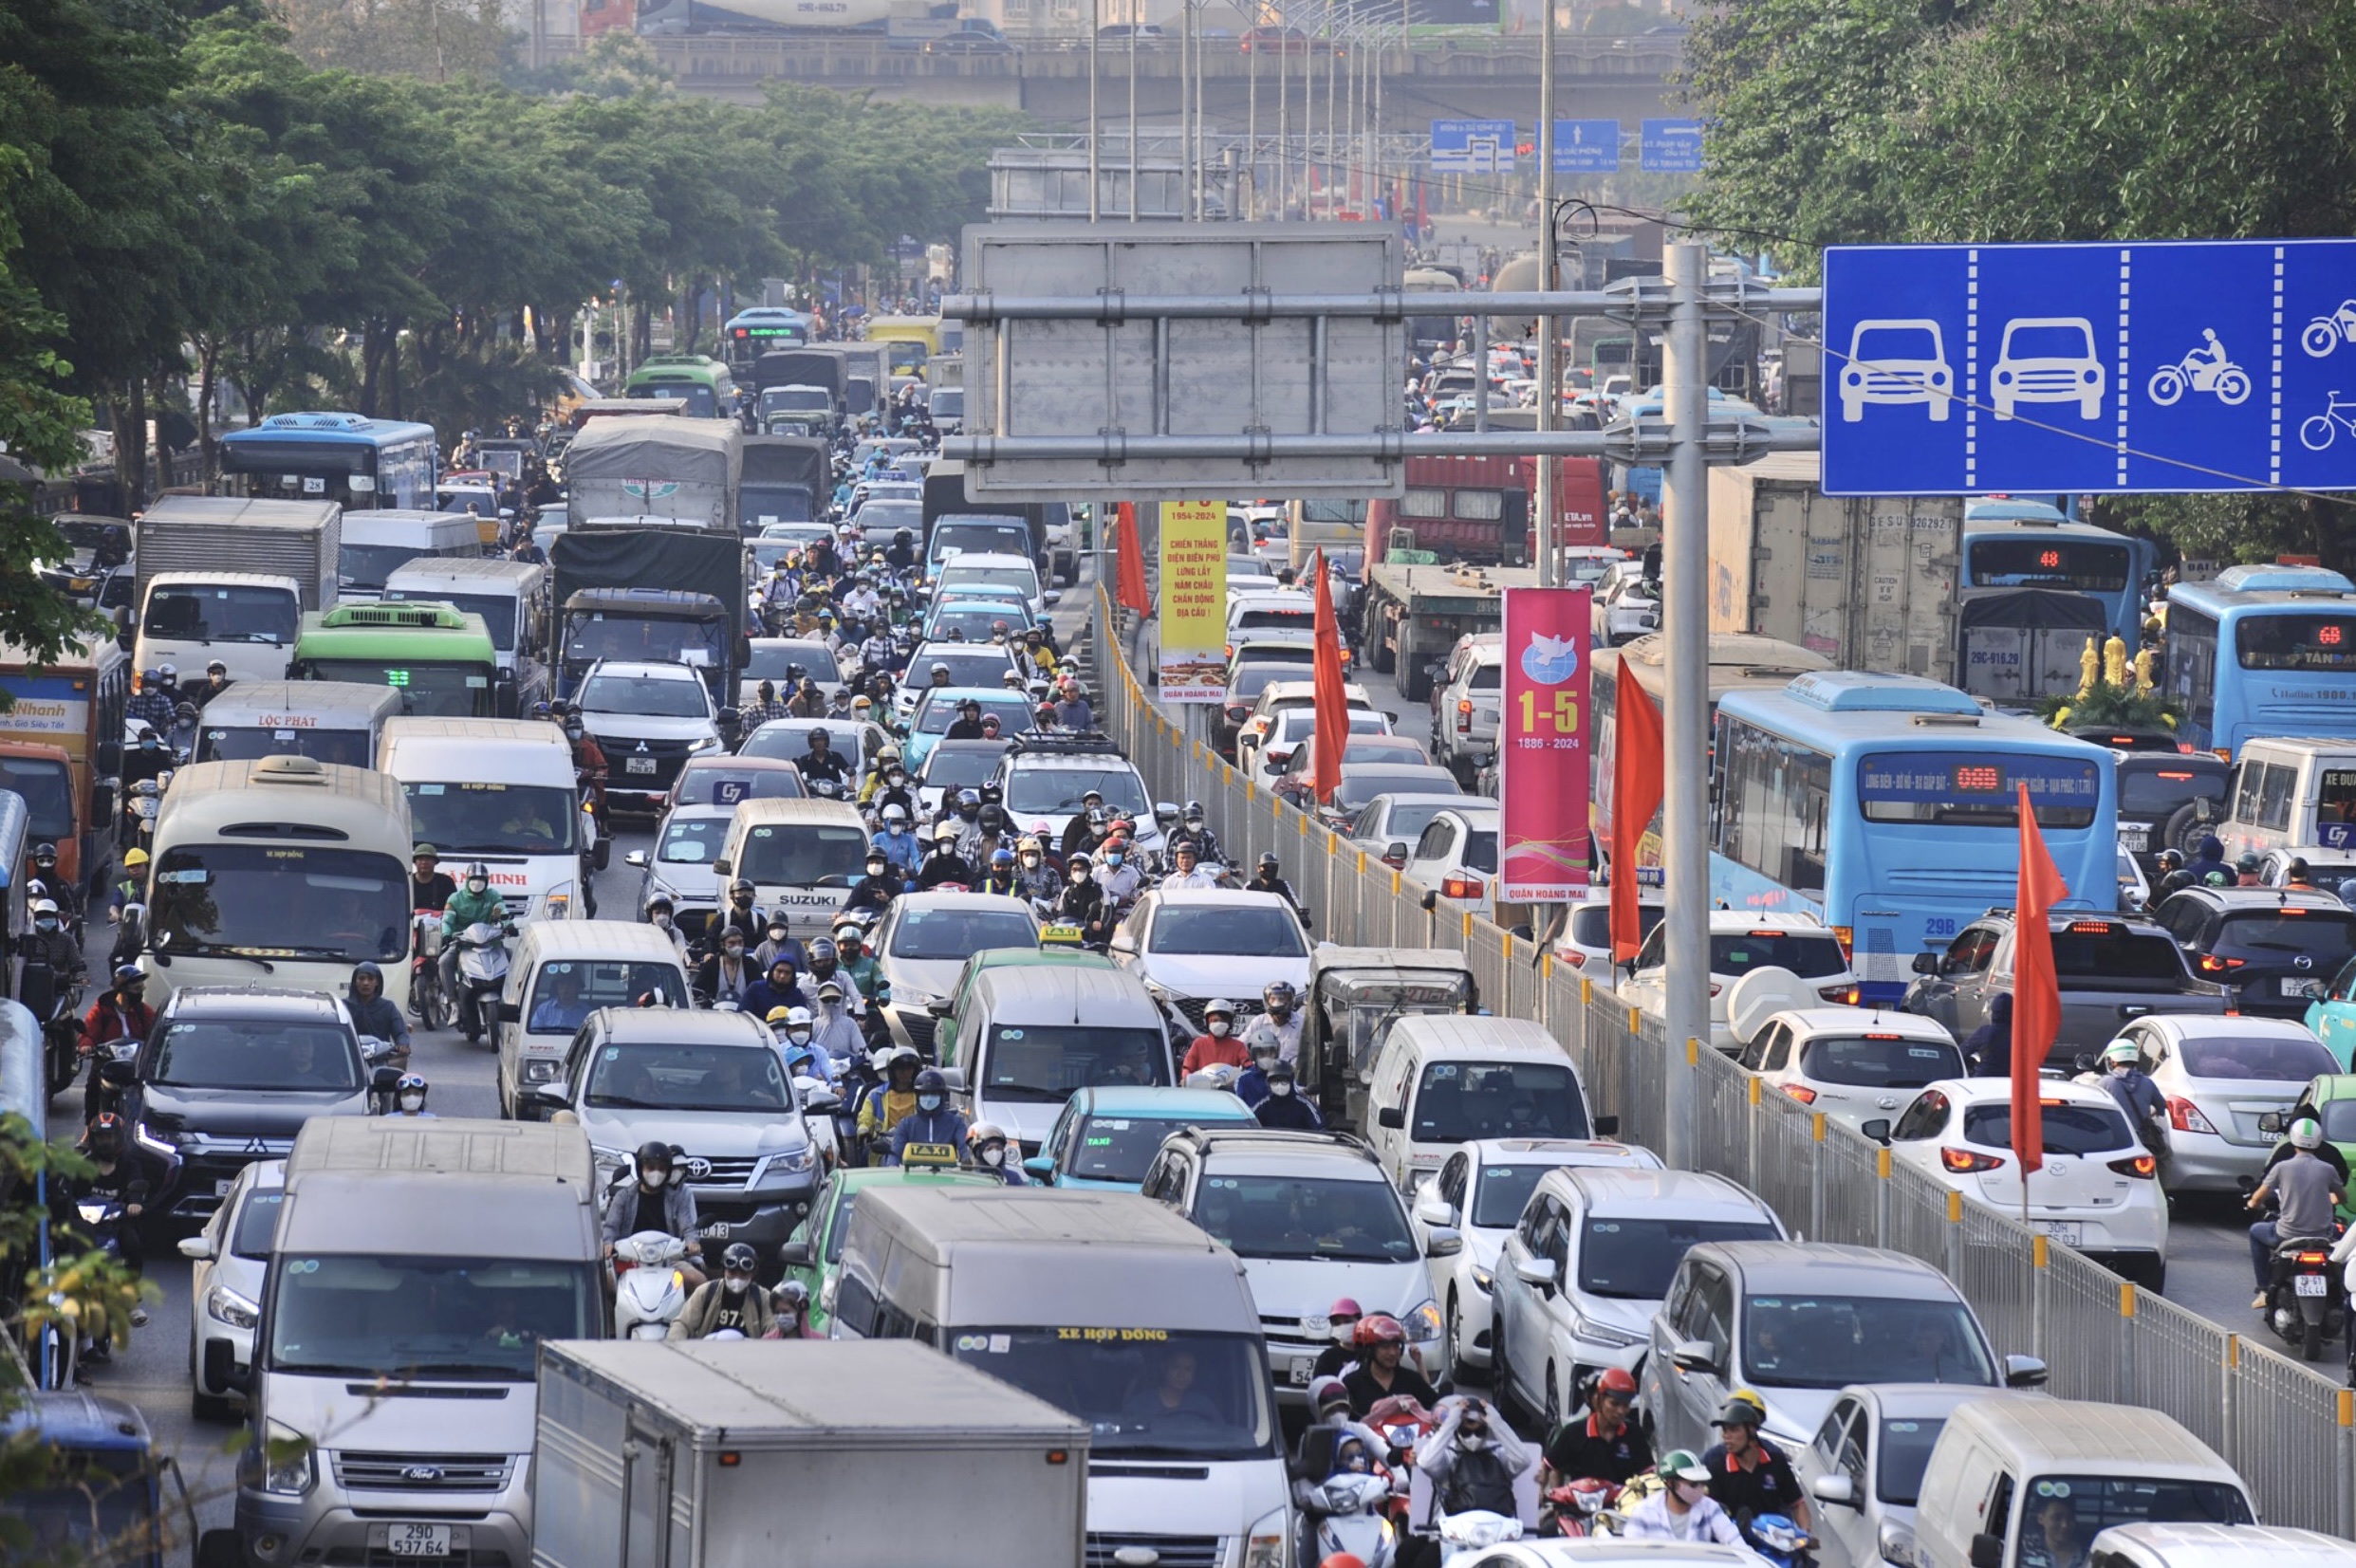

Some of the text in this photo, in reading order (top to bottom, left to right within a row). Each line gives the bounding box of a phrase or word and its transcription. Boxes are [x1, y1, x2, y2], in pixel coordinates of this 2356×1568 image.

[309, 481, 321, 490] 28
[1172, 511, 1216, 521] 1954-2024
[2041, 551, 2058, 566] 48
[1874, 576, 1898, 584] CAUTION
[1518, 691, 1578, 733] 1-5
[258, 713, 317, 728] LỘC PHÁT
[1518, 737, 1544, 749] 1886
[1553, 738, 1580, 749] 2024
[2326, 773, 2338, 786] XE
[779, 895, 837, 906] SUZUKI
[1509, 888, 1586, 900] QUẬN HOÀNG MAI
[1925, 917, 1955, 935] 29B
[1058, 1328, 1168, 1343] XE HỢP ĐỒNG
[394, 1540, 443, 1555] 537.64
